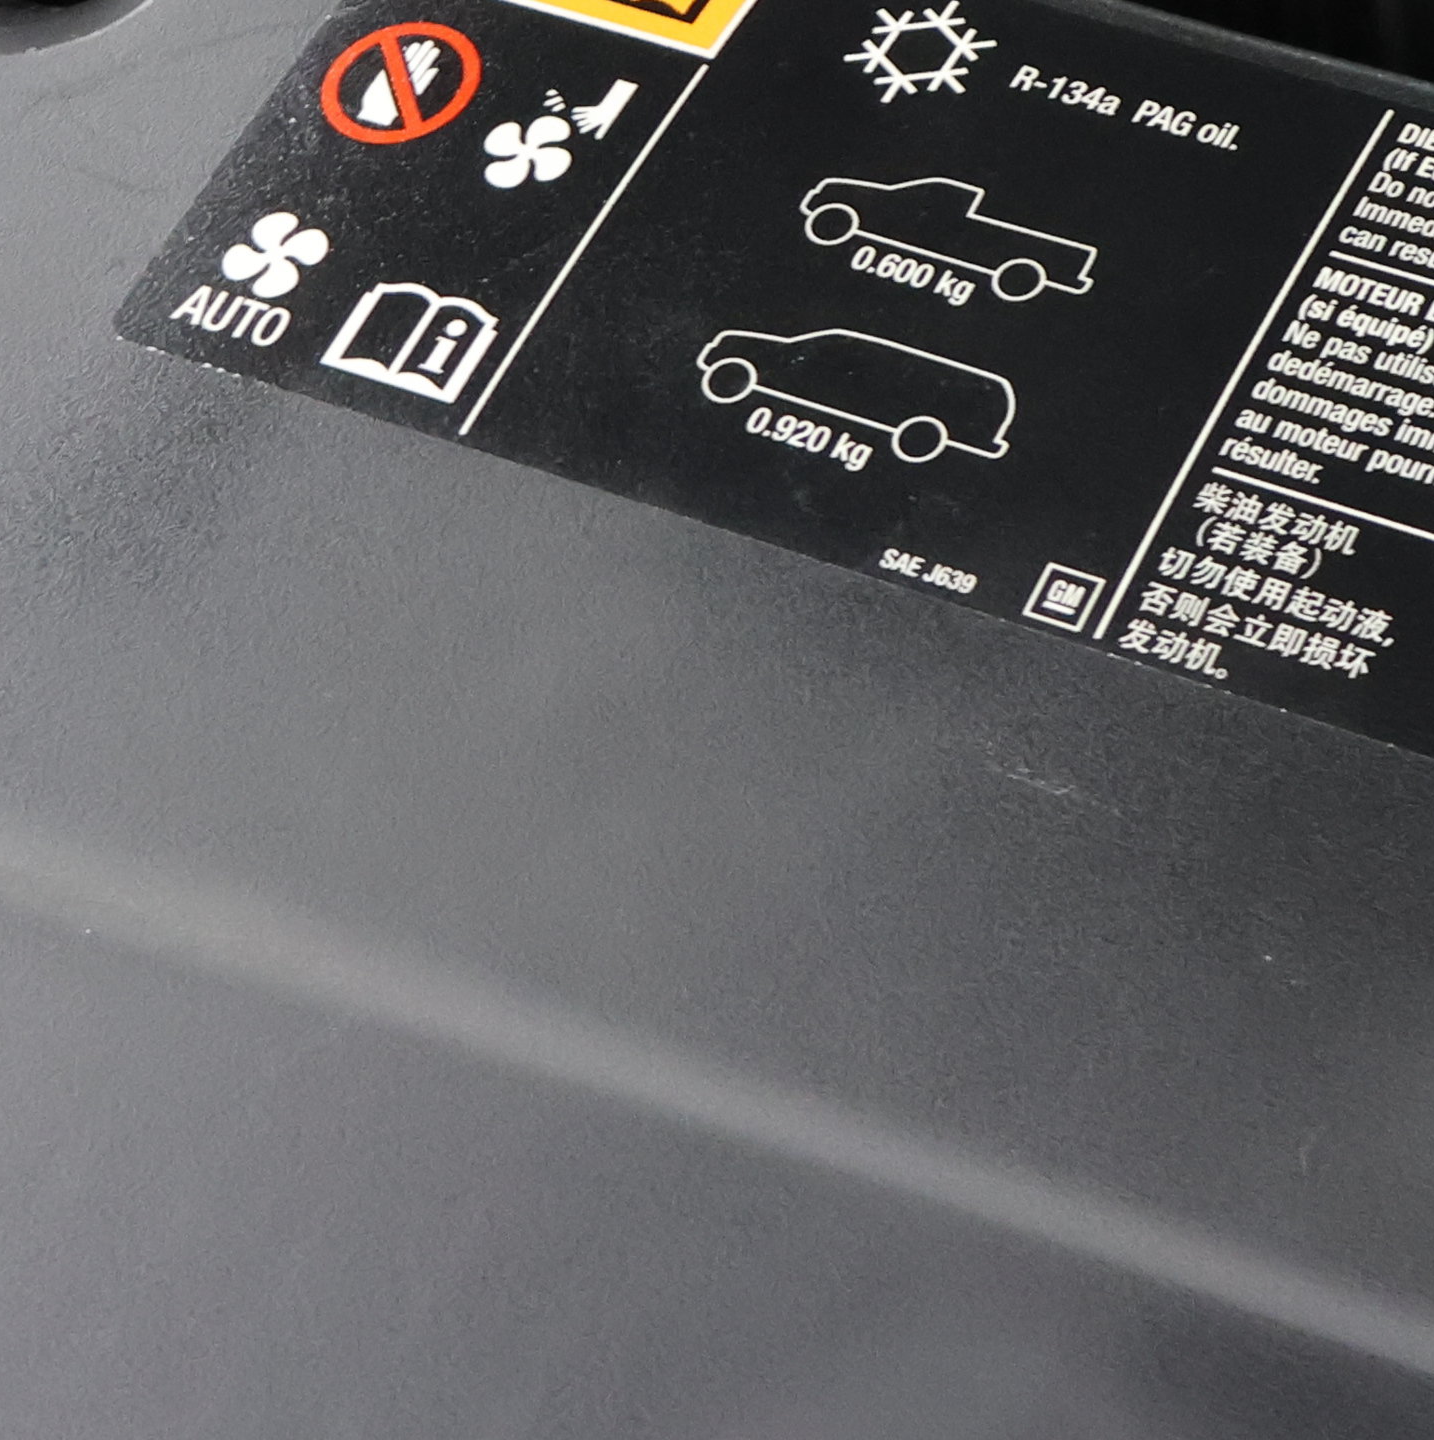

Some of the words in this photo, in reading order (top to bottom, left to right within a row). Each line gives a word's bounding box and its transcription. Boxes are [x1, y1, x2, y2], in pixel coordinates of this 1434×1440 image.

[1008, 64, 1122, 117] R-134a
[1130, 99, 1198, 137] PAG
[1195, 121, 1241, 151] oil.
[1366, 170, 1406, 199] Do
[1381, 146, 1420, 173] (If
[1338, 225, 1388, 253] can
[850, 244, 936, 289] 0.600
[932, 268, 977, 307] kg
[1311, 265, 1426, 317] MOTEUR
[167, 281, 292, 348] AUTO
[1297, 293, 1339, 322] (si
[1281, 319, 1322, 350] Ne
[1318, 336, 1373, 365] pas
[1250, 377, 1394, 437] dommages
[745, 406, 833, 454] 0.920
[828, 431, 874, 472] kg
[1217, 435, 1324, 485] résulter.
[1234, 408, 1274, 435] au
[1271, 419, 1371, 463] moteur
[1191, 481, 1361, 556] 柴油发动机
[920, 562, 978, 595] J639
[1043, 578, 1087, 612] GM
[1117, 618, 1229, 680] 发动机。
[1138, 580, 1377, 680] 否则会立即损坏
